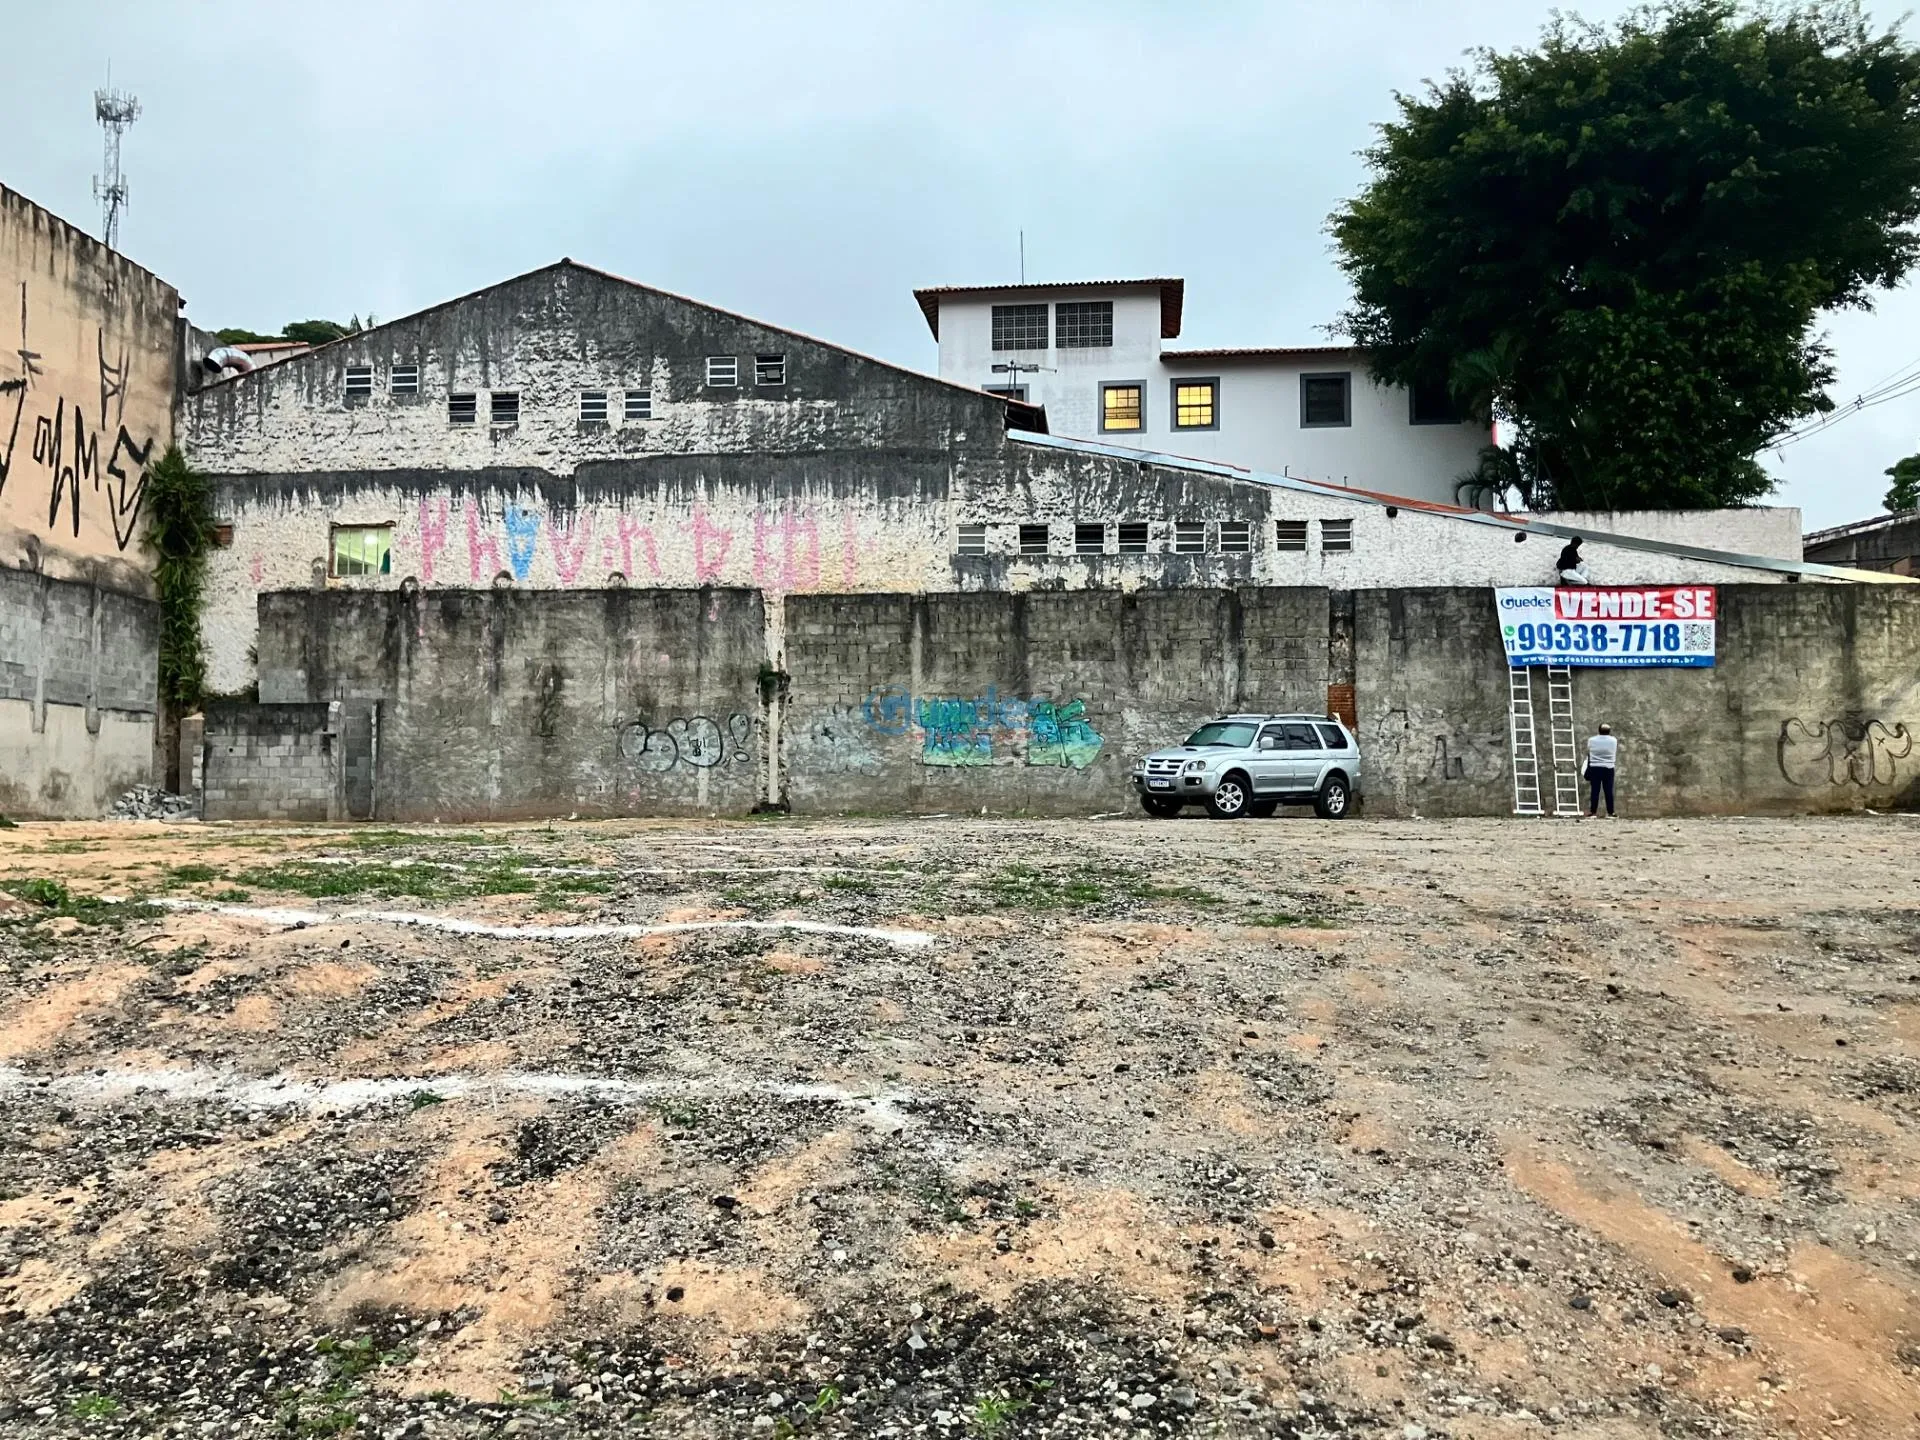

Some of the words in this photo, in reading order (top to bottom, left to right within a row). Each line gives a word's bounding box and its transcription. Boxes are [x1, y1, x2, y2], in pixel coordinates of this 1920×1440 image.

[1501, 595, 1551, 609] Guedes
[1558, 591, 1712, 618] VENDE-SE
[1505, 639, 1515, 651] 11
[1518, 623, 1680, 651] 99338-7718
